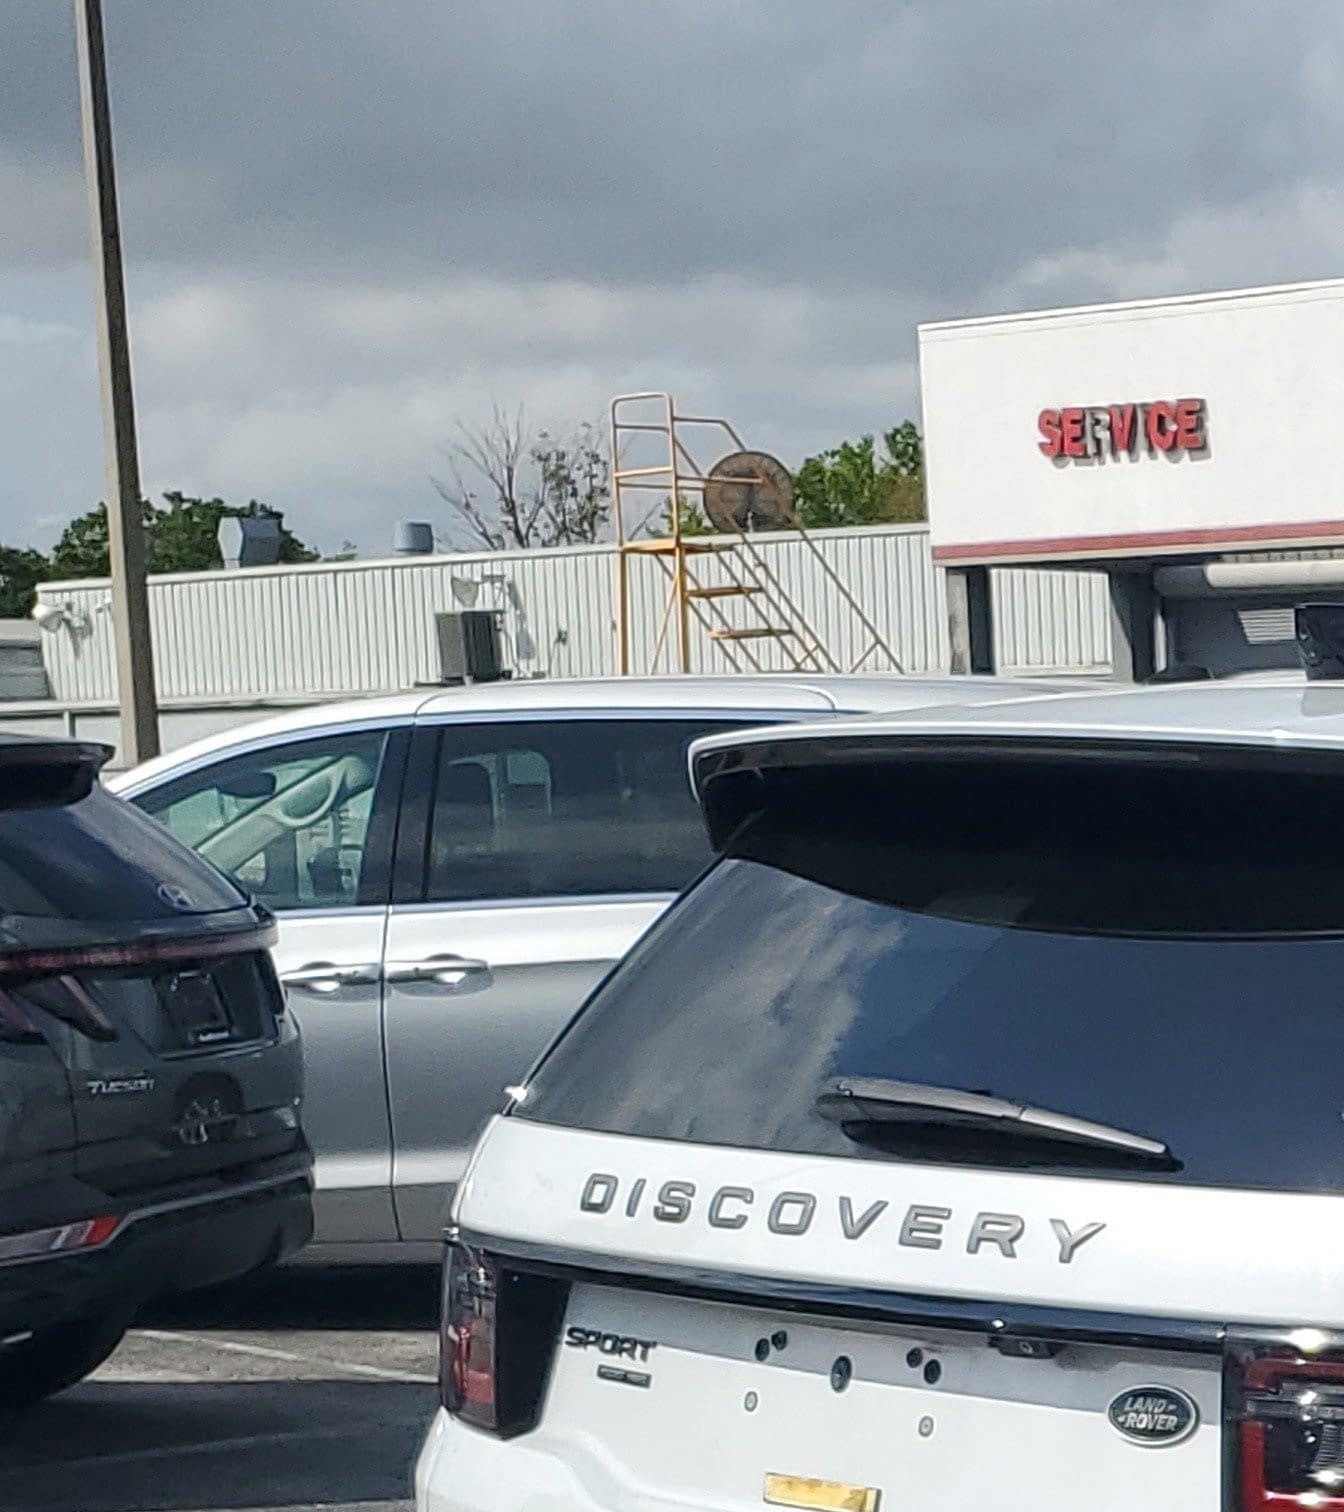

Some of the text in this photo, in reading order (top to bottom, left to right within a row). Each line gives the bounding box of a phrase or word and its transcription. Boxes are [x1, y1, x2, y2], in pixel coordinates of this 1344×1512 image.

[1038, 397, 1208, 461] SERVICE
[579, 1173, 1107, 1264] DISCOVERY
[565, 1326, 657, 1363] SPORT
